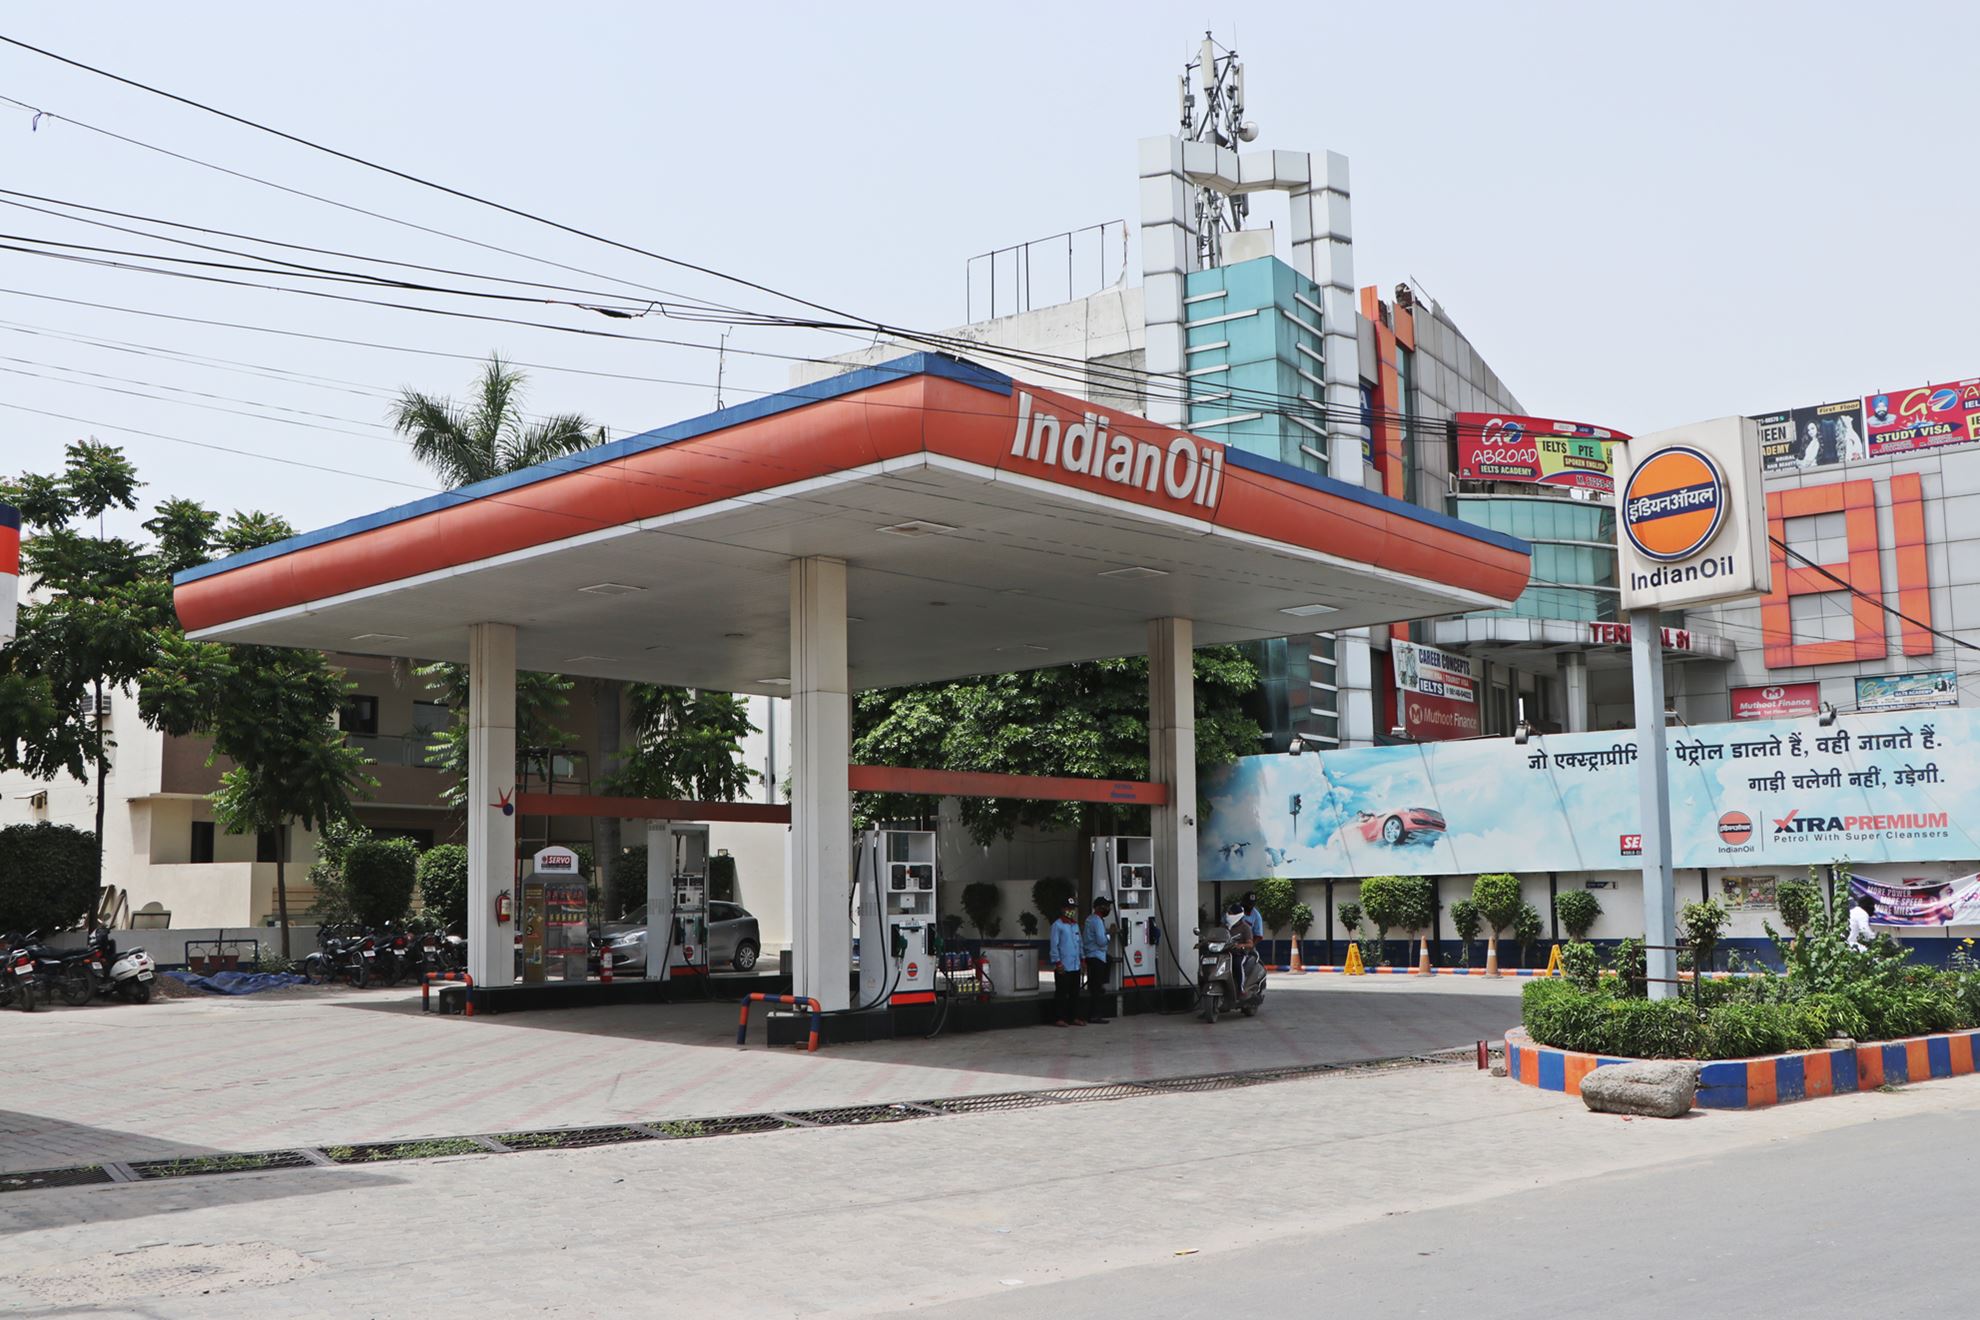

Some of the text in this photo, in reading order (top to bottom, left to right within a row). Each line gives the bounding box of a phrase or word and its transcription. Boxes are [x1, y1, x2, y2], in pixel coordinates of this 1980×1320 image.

[1876, 429, 1917, 443] STUDY
[1920, 424, 1952, 437] VISA
[1010, 391, 1224, 509] IndianOil
[1542, 440, 1568, 454] IELTS
[1578, 445, 1594, 458] PTE
[1472, 449, 1537, 465] ABROAD
[1565, 457, 1606, 470] SPOKEN ENGLISH
[1481, 464, 1499, 474] IELTS
[1501, 465, 1533, 476] ACADEMY
[1629, 487, 1714, 523] इंडियनऑयल
[1631, 556, 1734, 591] IndianOil
[1419, 649, 1441, 668] CAREER
[1441, 653, 1471, 676] CONCEPTS
[1420, 680, 1443, 694] IELTS
[1740, 698, 1811, 710] Muthoot Finance
[1424, 707, 1477, 729] Muthoot Finance
[1528, 749, 1548, 770] जो
[1675, 739, 1724, 766] पेट्रोल
[1730, 734, 1782, 758] डालते
[1788, 732, 1809, 757] हैं,
[1816, 729, 1850, 755] वही
[1857, 726, 1913, 751] जानते
[1920, 724, 1943, 750] हैं.
[1748, 762, 1945, 793] गाड़ी चलेगी नहीं, उड़ेगी.
[1772, 808, 1948, 834] XTRAPREMIUM
[1773, 830, 1949, 843] Petrol With Super Cleansers
[1718, 845, 1755, 853] IndianOil
[548, 856, 571, 864] SERVO
[1868, 885, 1886, 897] MORE
[1887, 886, 1912, 898] POWER
[1881, 895, 1923, 907] MORE SPEED
[1874, 903, 1914, 916] MORE MILES
